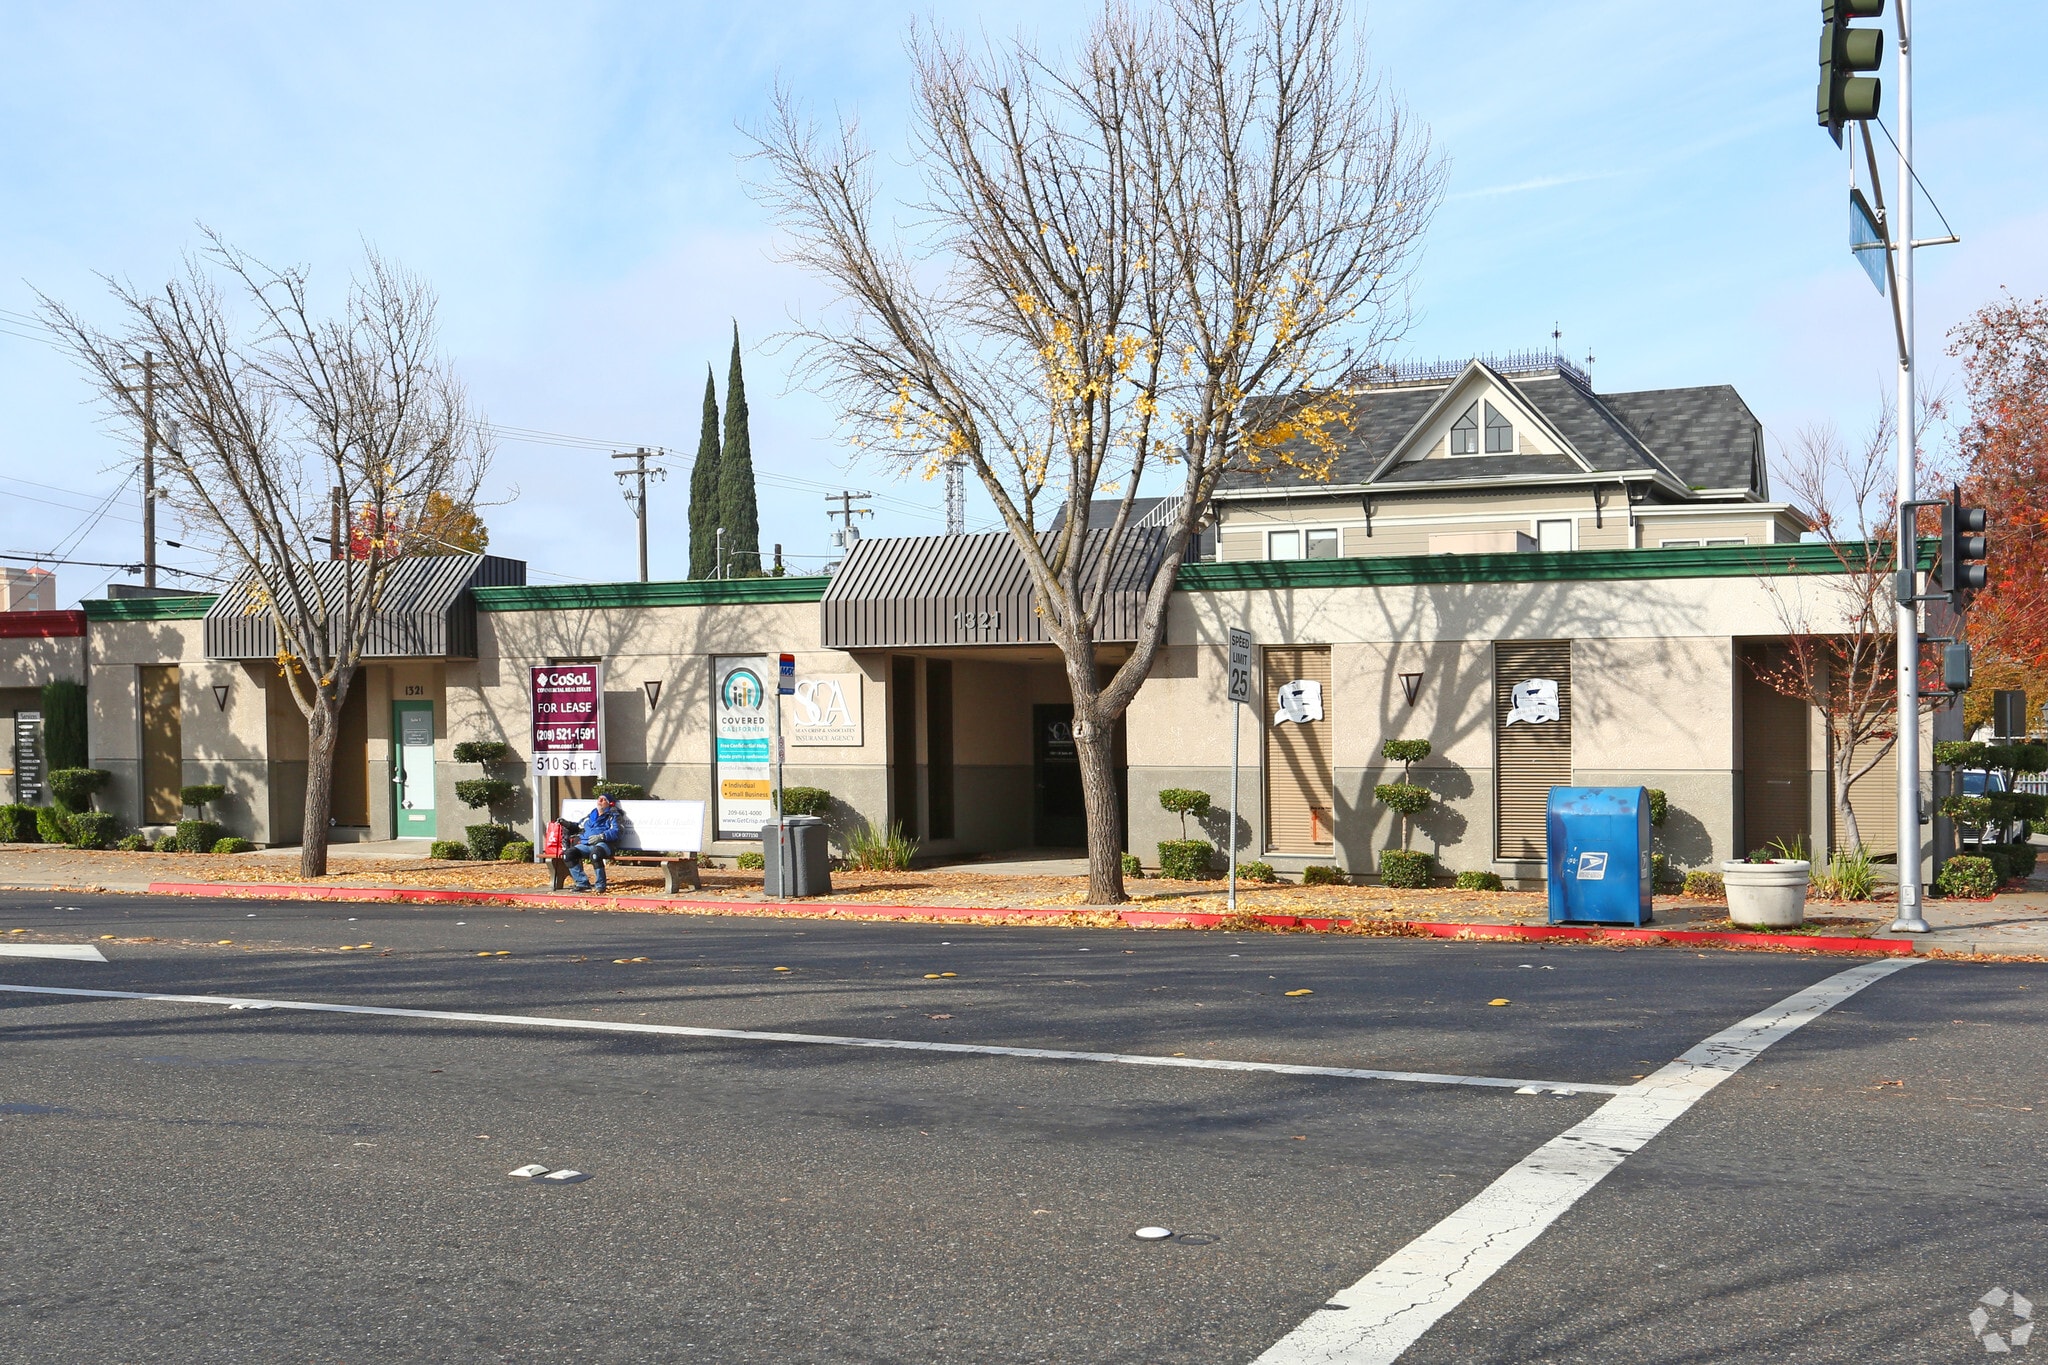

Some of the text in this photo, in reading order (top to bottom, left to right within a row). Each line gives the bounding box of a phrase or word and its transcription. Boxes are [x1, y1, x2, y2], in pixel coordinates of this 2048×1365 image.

[954, 611, 1000, 629] 1321
[1232, 635, 1249, 649] SPEED
[1233, 652, 1247, 665] LIMIT
[1232, 668, 1247, 696] 25
[405, 685, 423, 696] 1321
[537, 702, 592, 713] FOR LEASE
[536, 727, 596, 742] (209) 521-1591
[537, 757, 597, 773] 510 Sq. Ft.
